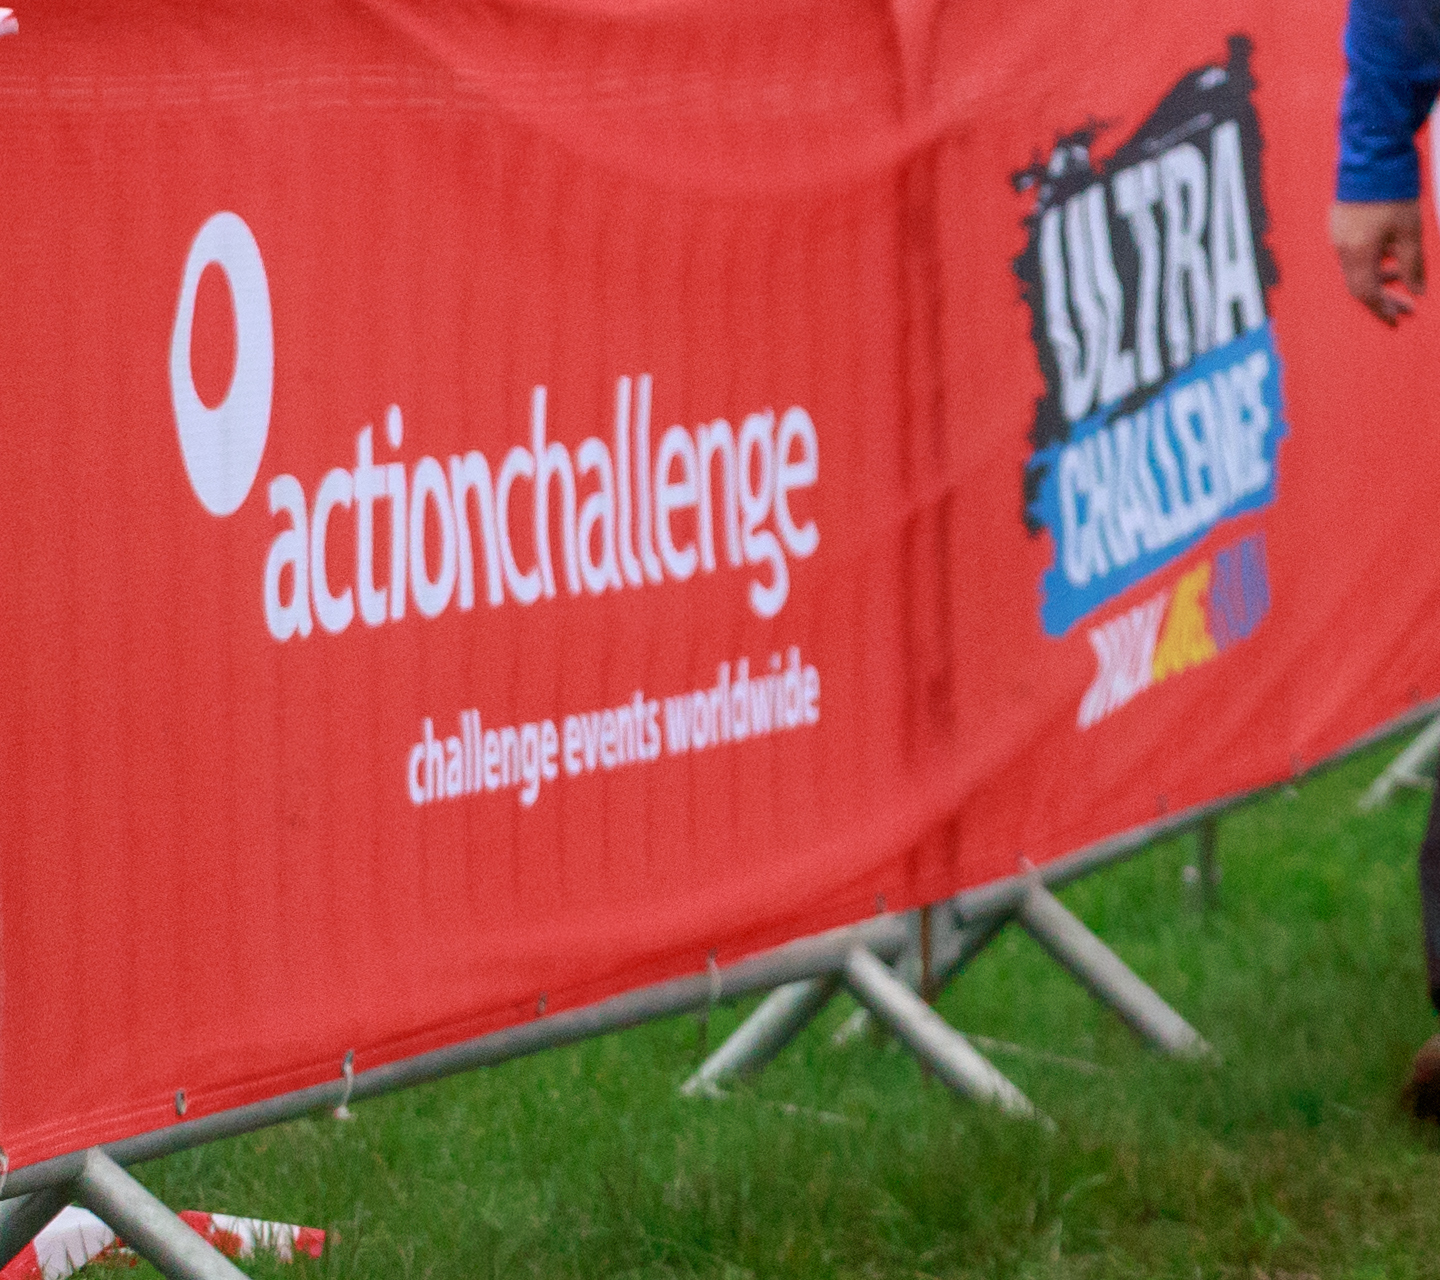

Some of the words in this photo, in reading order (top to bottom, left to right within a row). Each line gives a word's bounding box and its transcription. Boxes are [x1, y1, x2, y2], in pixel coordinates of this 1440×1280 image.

[1036, 118, 1266, 422] ULTRA
[263, 373, 821, 642] actionchallenge
[407, 707, 559, 807] challenge
[563, 690, 660, 776] events
[663, 645, 821, 751] worldwide
